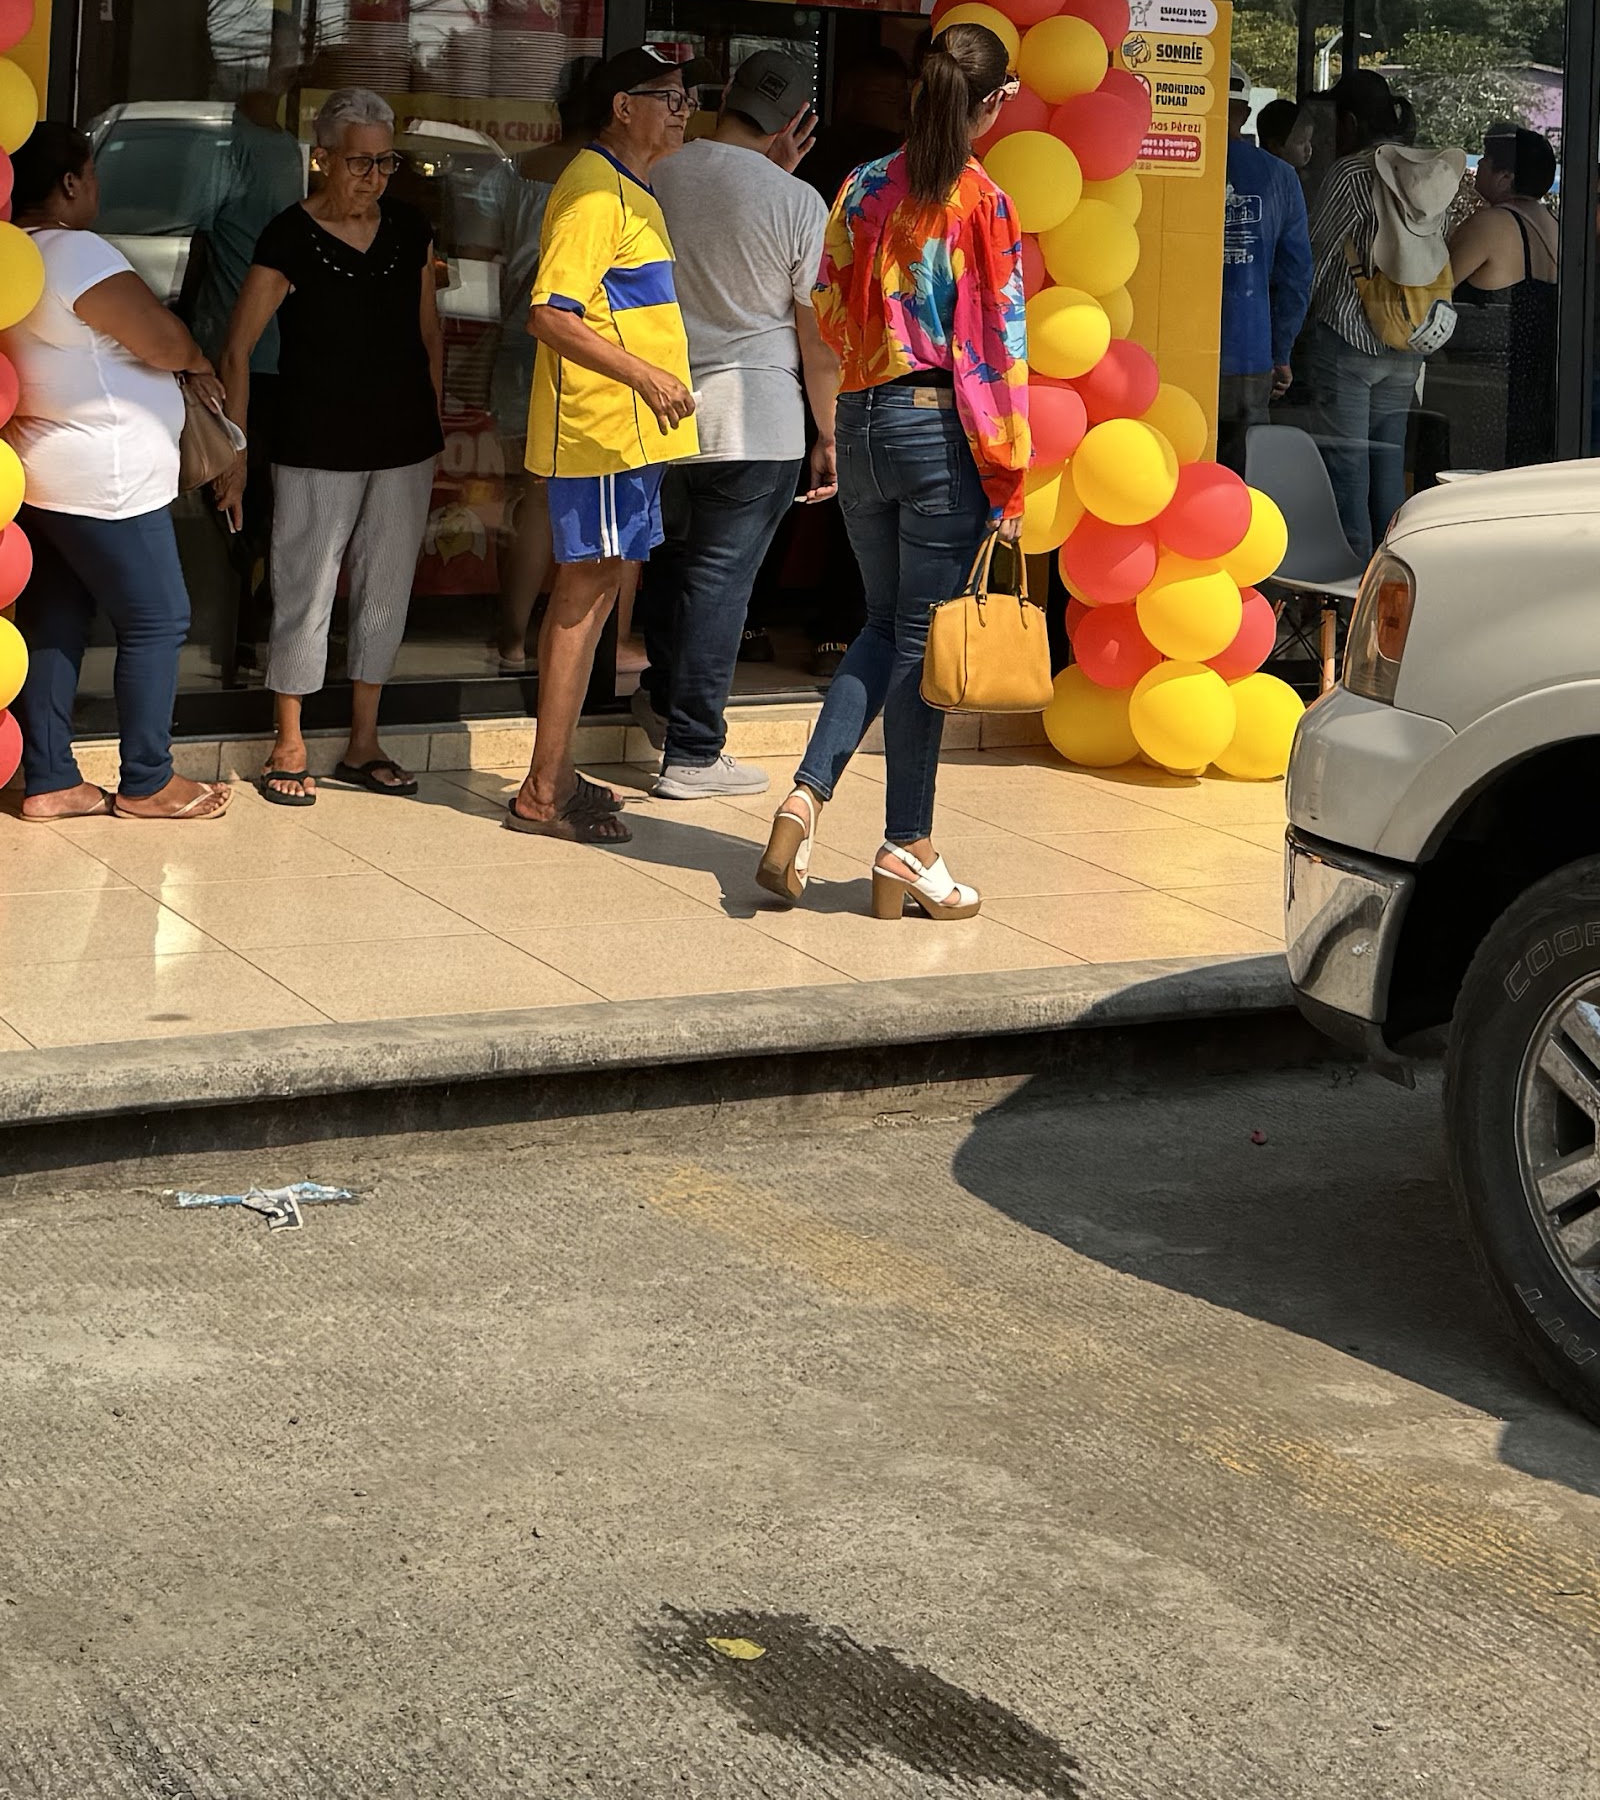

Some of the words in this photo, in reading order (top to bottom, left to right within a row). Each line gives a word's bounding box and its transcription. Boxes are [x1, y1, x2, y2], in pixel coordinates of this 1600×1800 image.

[1156, 41, 1203, 60] SONRÍE
[1156, 82, 1206, 96] PROHIBIDO
[1155, 95, 1188, 107] FUMAR
